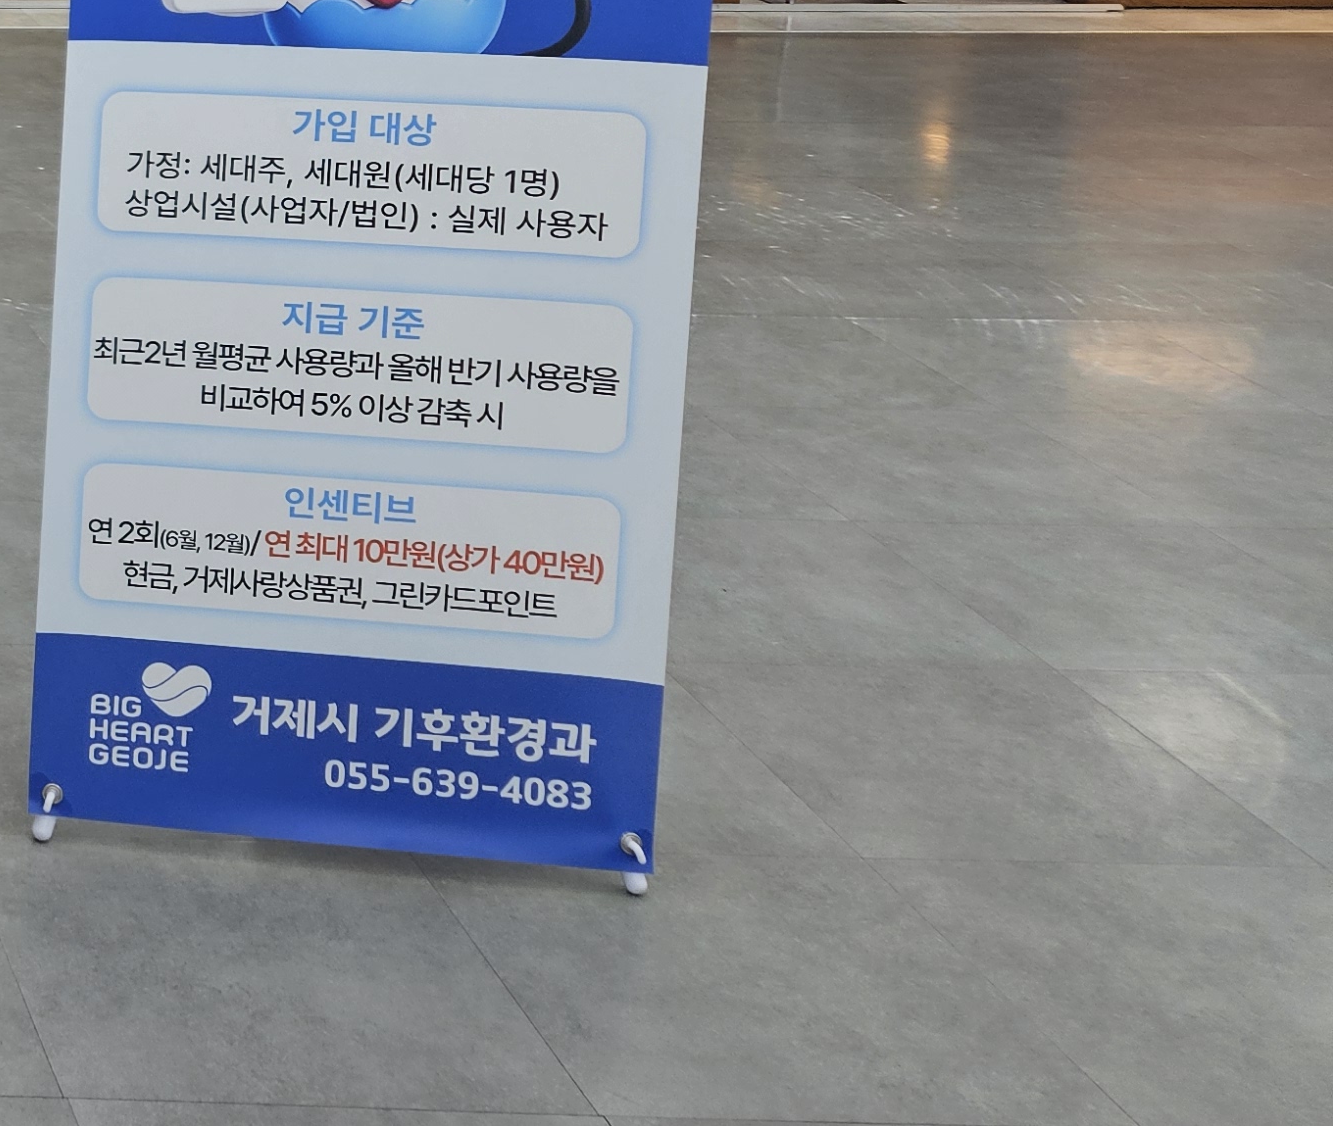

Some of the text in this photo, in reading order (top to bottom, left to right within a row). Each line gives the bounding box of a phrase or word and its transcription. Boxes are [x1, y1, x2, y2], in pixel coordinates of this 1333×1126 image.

[291, 109, 437, 148] 가입 대상
[126, 150, 561, 201] 가정: 세대주, 세대원(세대당 1명)
[124, 189, 420, 235] 상업시설(사업자/법인)
[447, 203, 505, 237] 실제
[514, 207, 609, 242] 사용자
[281, 300, 426, 340] 지급 기준
[92, 336, 621, 397] 최근2년 월평균 사용량과 올해 반기 사용량을
[200, 385, 504, 430] 비교하여 5% 이상 감축 시
[283, 487, 417, 525] 인센티브
[87, 517, 114, 545] 연
[264, 529, 292, 560] 연
[295, 530, 349, 563] 최대
[352, 535, 501, 576] 10만원(상가
[503, 545, 605, 585] 40만원)
[121, 560, 558, 620] 현금, 거제사랑상품권, 그린카드포인트
[90, 693, 142, 718] BIG
[231, 694, 598, 765] 거제시 기후환경과
[89, 717, 194, 748] HEART
[88, 742, 190, 774] GEOJE
[323, 758, 593, 811] 055-639-4083
